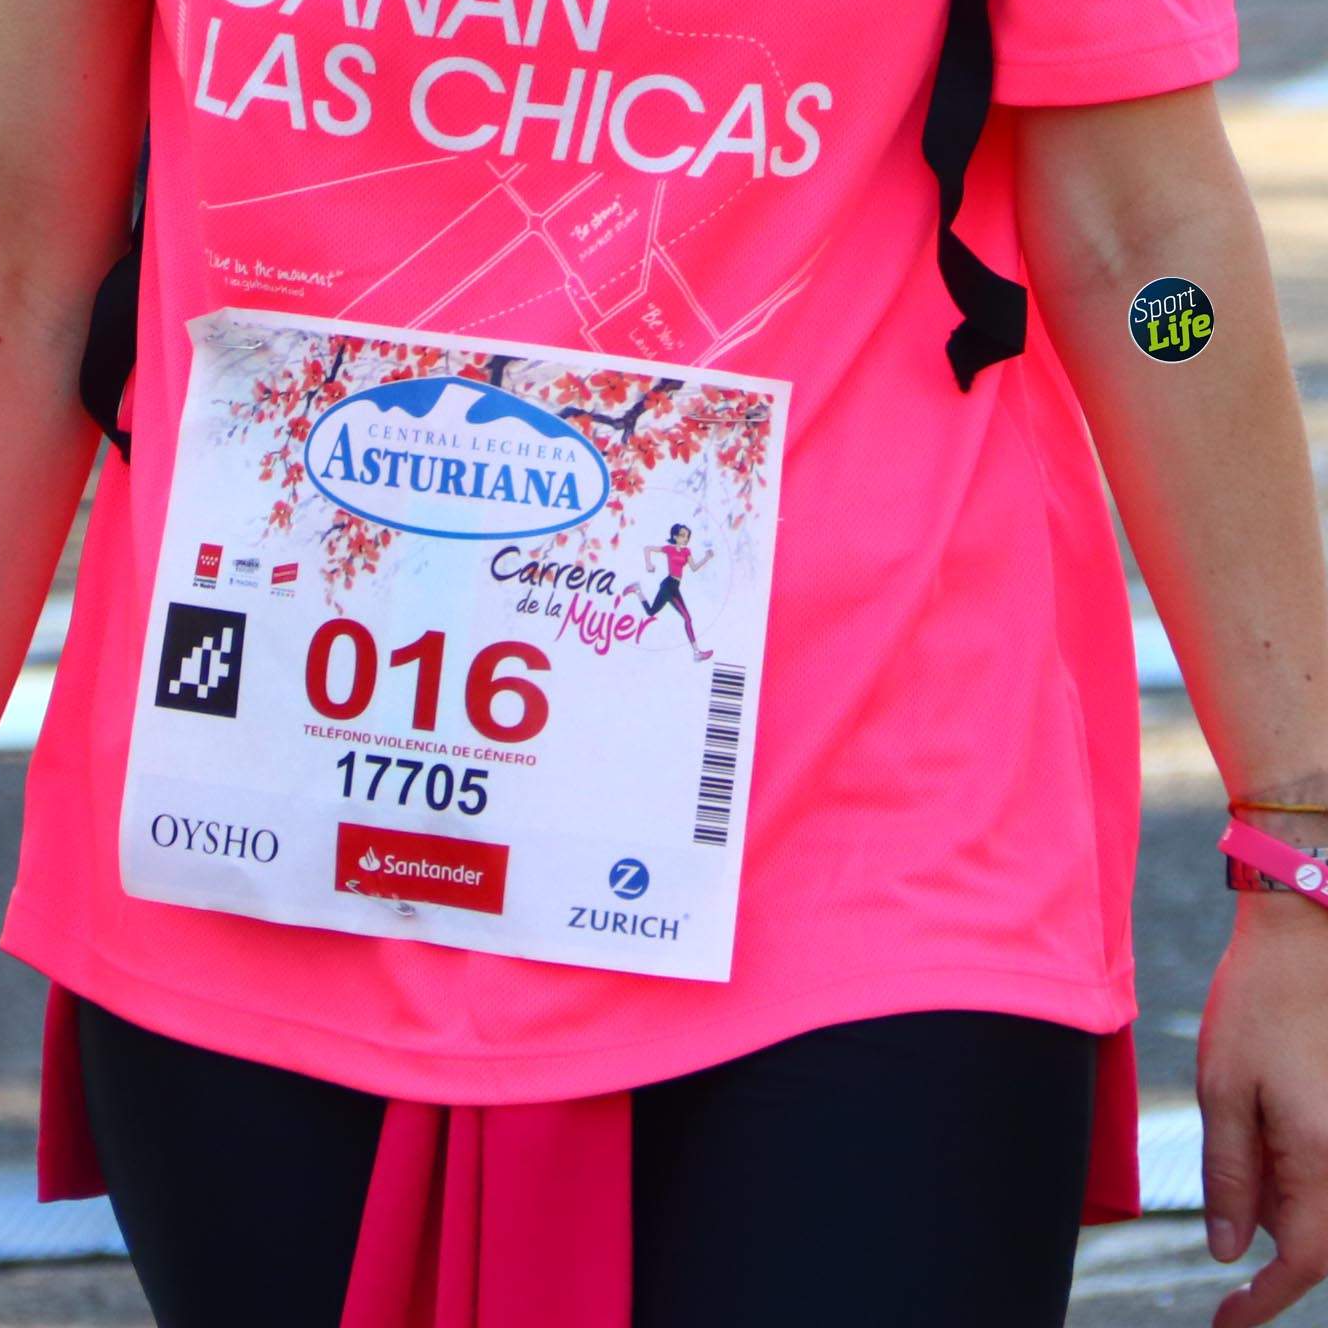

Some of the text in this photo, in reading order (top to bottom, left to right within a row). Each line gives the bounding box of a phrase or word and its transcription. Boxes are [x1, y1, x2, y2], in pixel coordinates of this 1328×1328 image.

[194, 17, 833, 179] LAS CHICAS
[320, 422, 582, 511] ASTURIANA
[368, 423, 577, 463] CENTRAL LECHERA
[490, 545, 617, 596] Carrera
[516, 587, 658, 656] de la Mujer
[304, 617, 553, 744] 016
[303, 723, 537, 767] TELÉFONO VIOLENCIA DE GÉNERO
[336, 750, 490, 815] 17705
[151, 813, 280, 864] OYSHO
[383, 853, 485, 886] Santander
[567, 906, 680, 941] ZURICH
